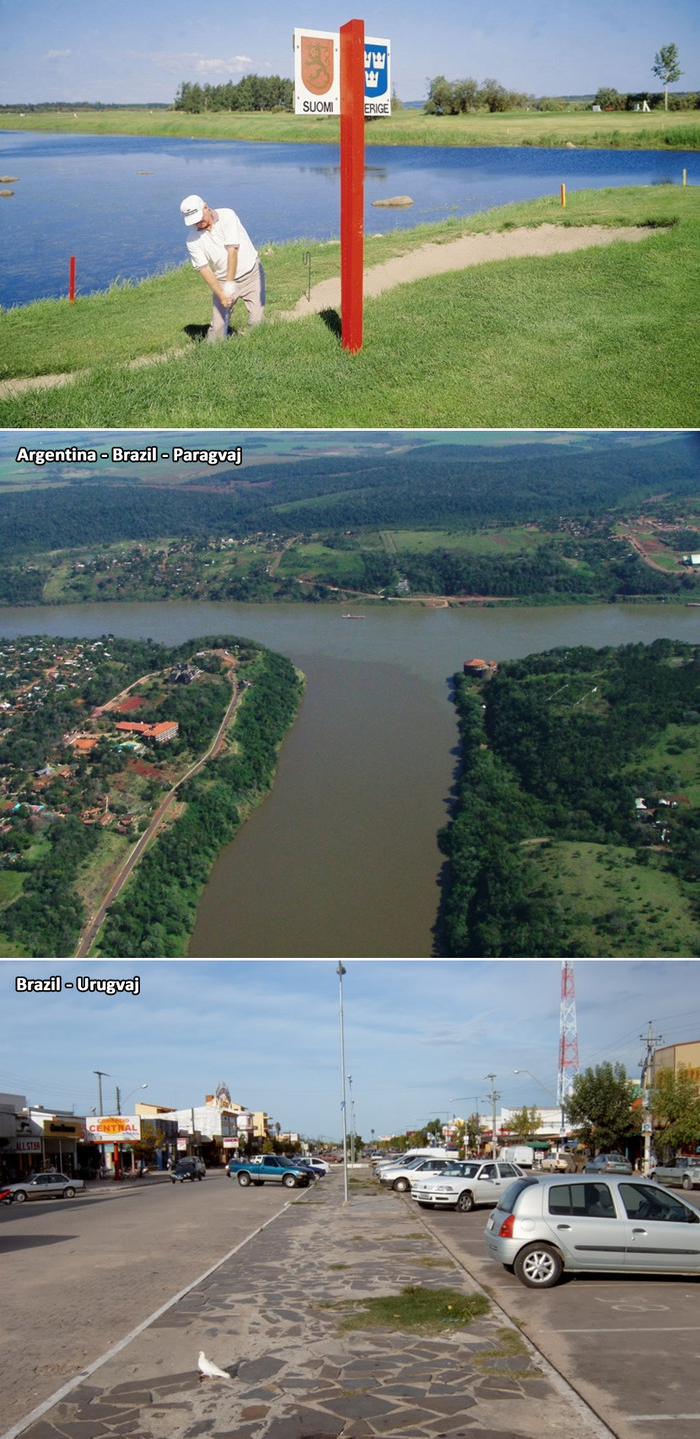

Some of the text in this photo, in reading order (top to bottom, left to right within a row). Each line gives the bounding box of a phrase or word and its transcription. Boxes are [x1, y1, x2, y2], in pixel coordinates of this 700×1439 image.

[303, 101, 333, 112] SUOMI
[364, 103, 389, 113] ERIGE
[89, 1124, 138, 1132] CENTRAL
